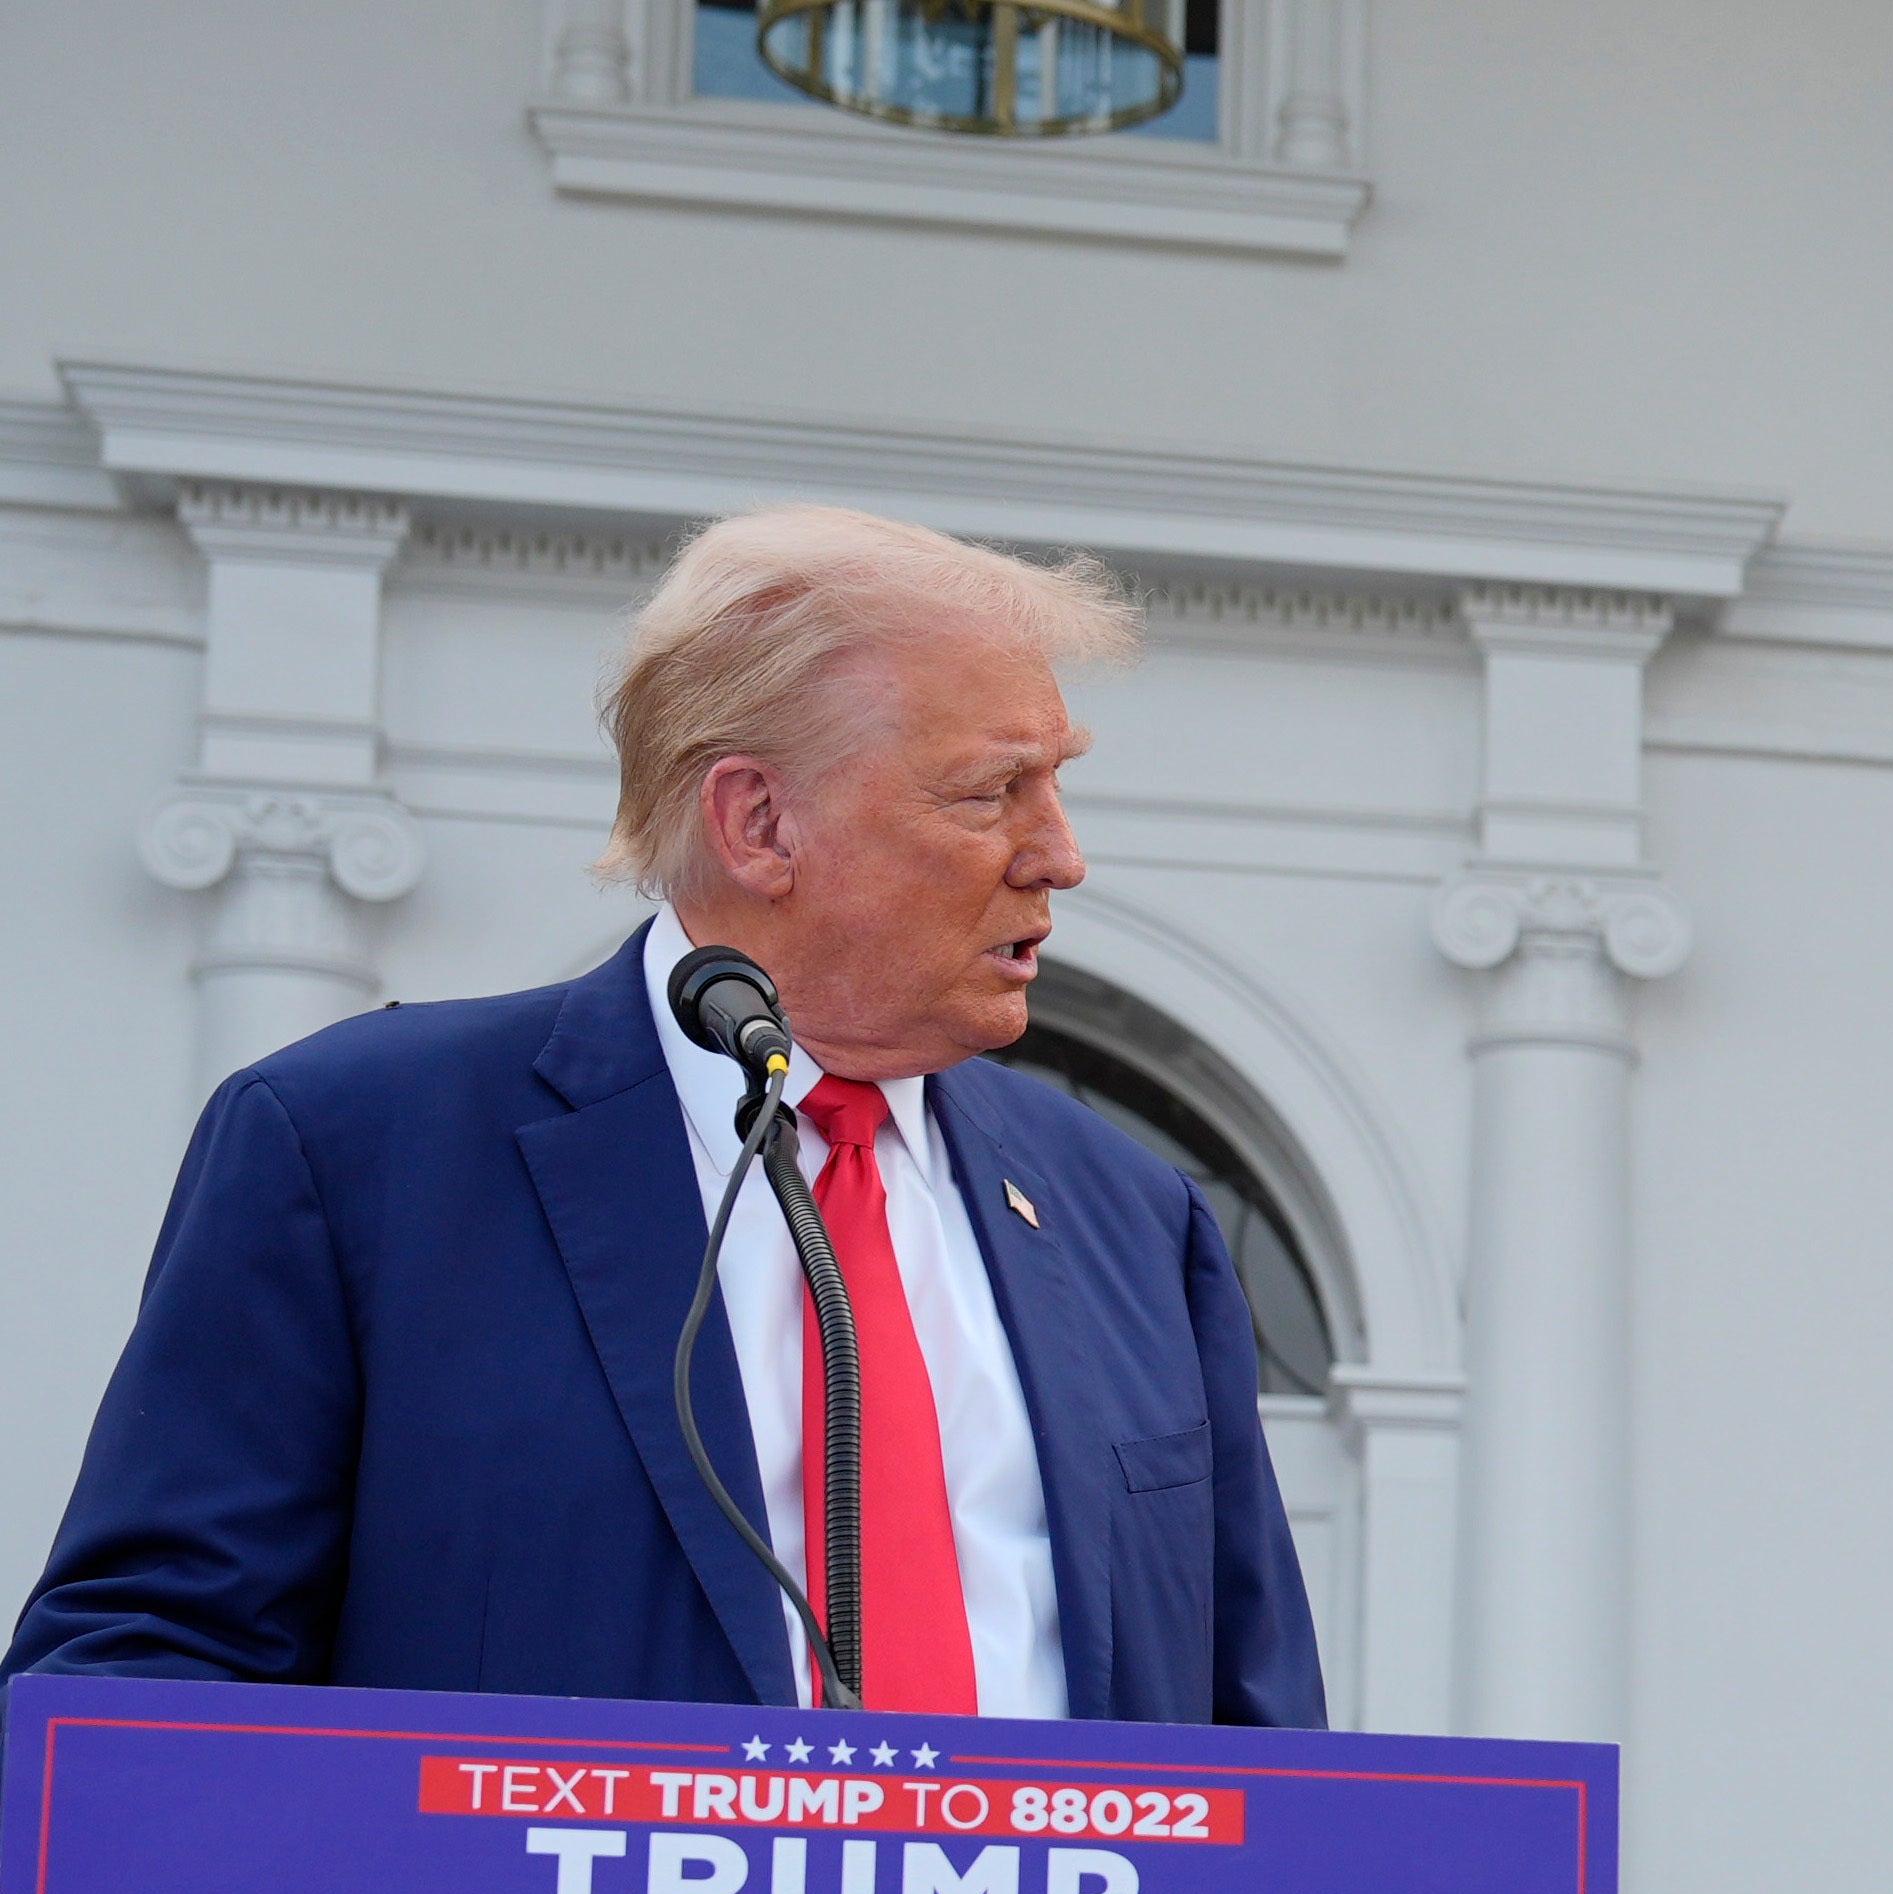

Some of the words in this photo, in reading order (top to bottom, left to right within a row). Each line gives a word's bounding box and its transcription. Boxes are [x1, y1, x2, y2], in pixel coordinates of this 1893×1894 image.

[458, 1763, 630, 1815] TEXT
[650, 1771, 885, 1825] TRUMP
[903, 1782, 989, 1829] TO
[1010, 1786, 1210, 1838] 88022
